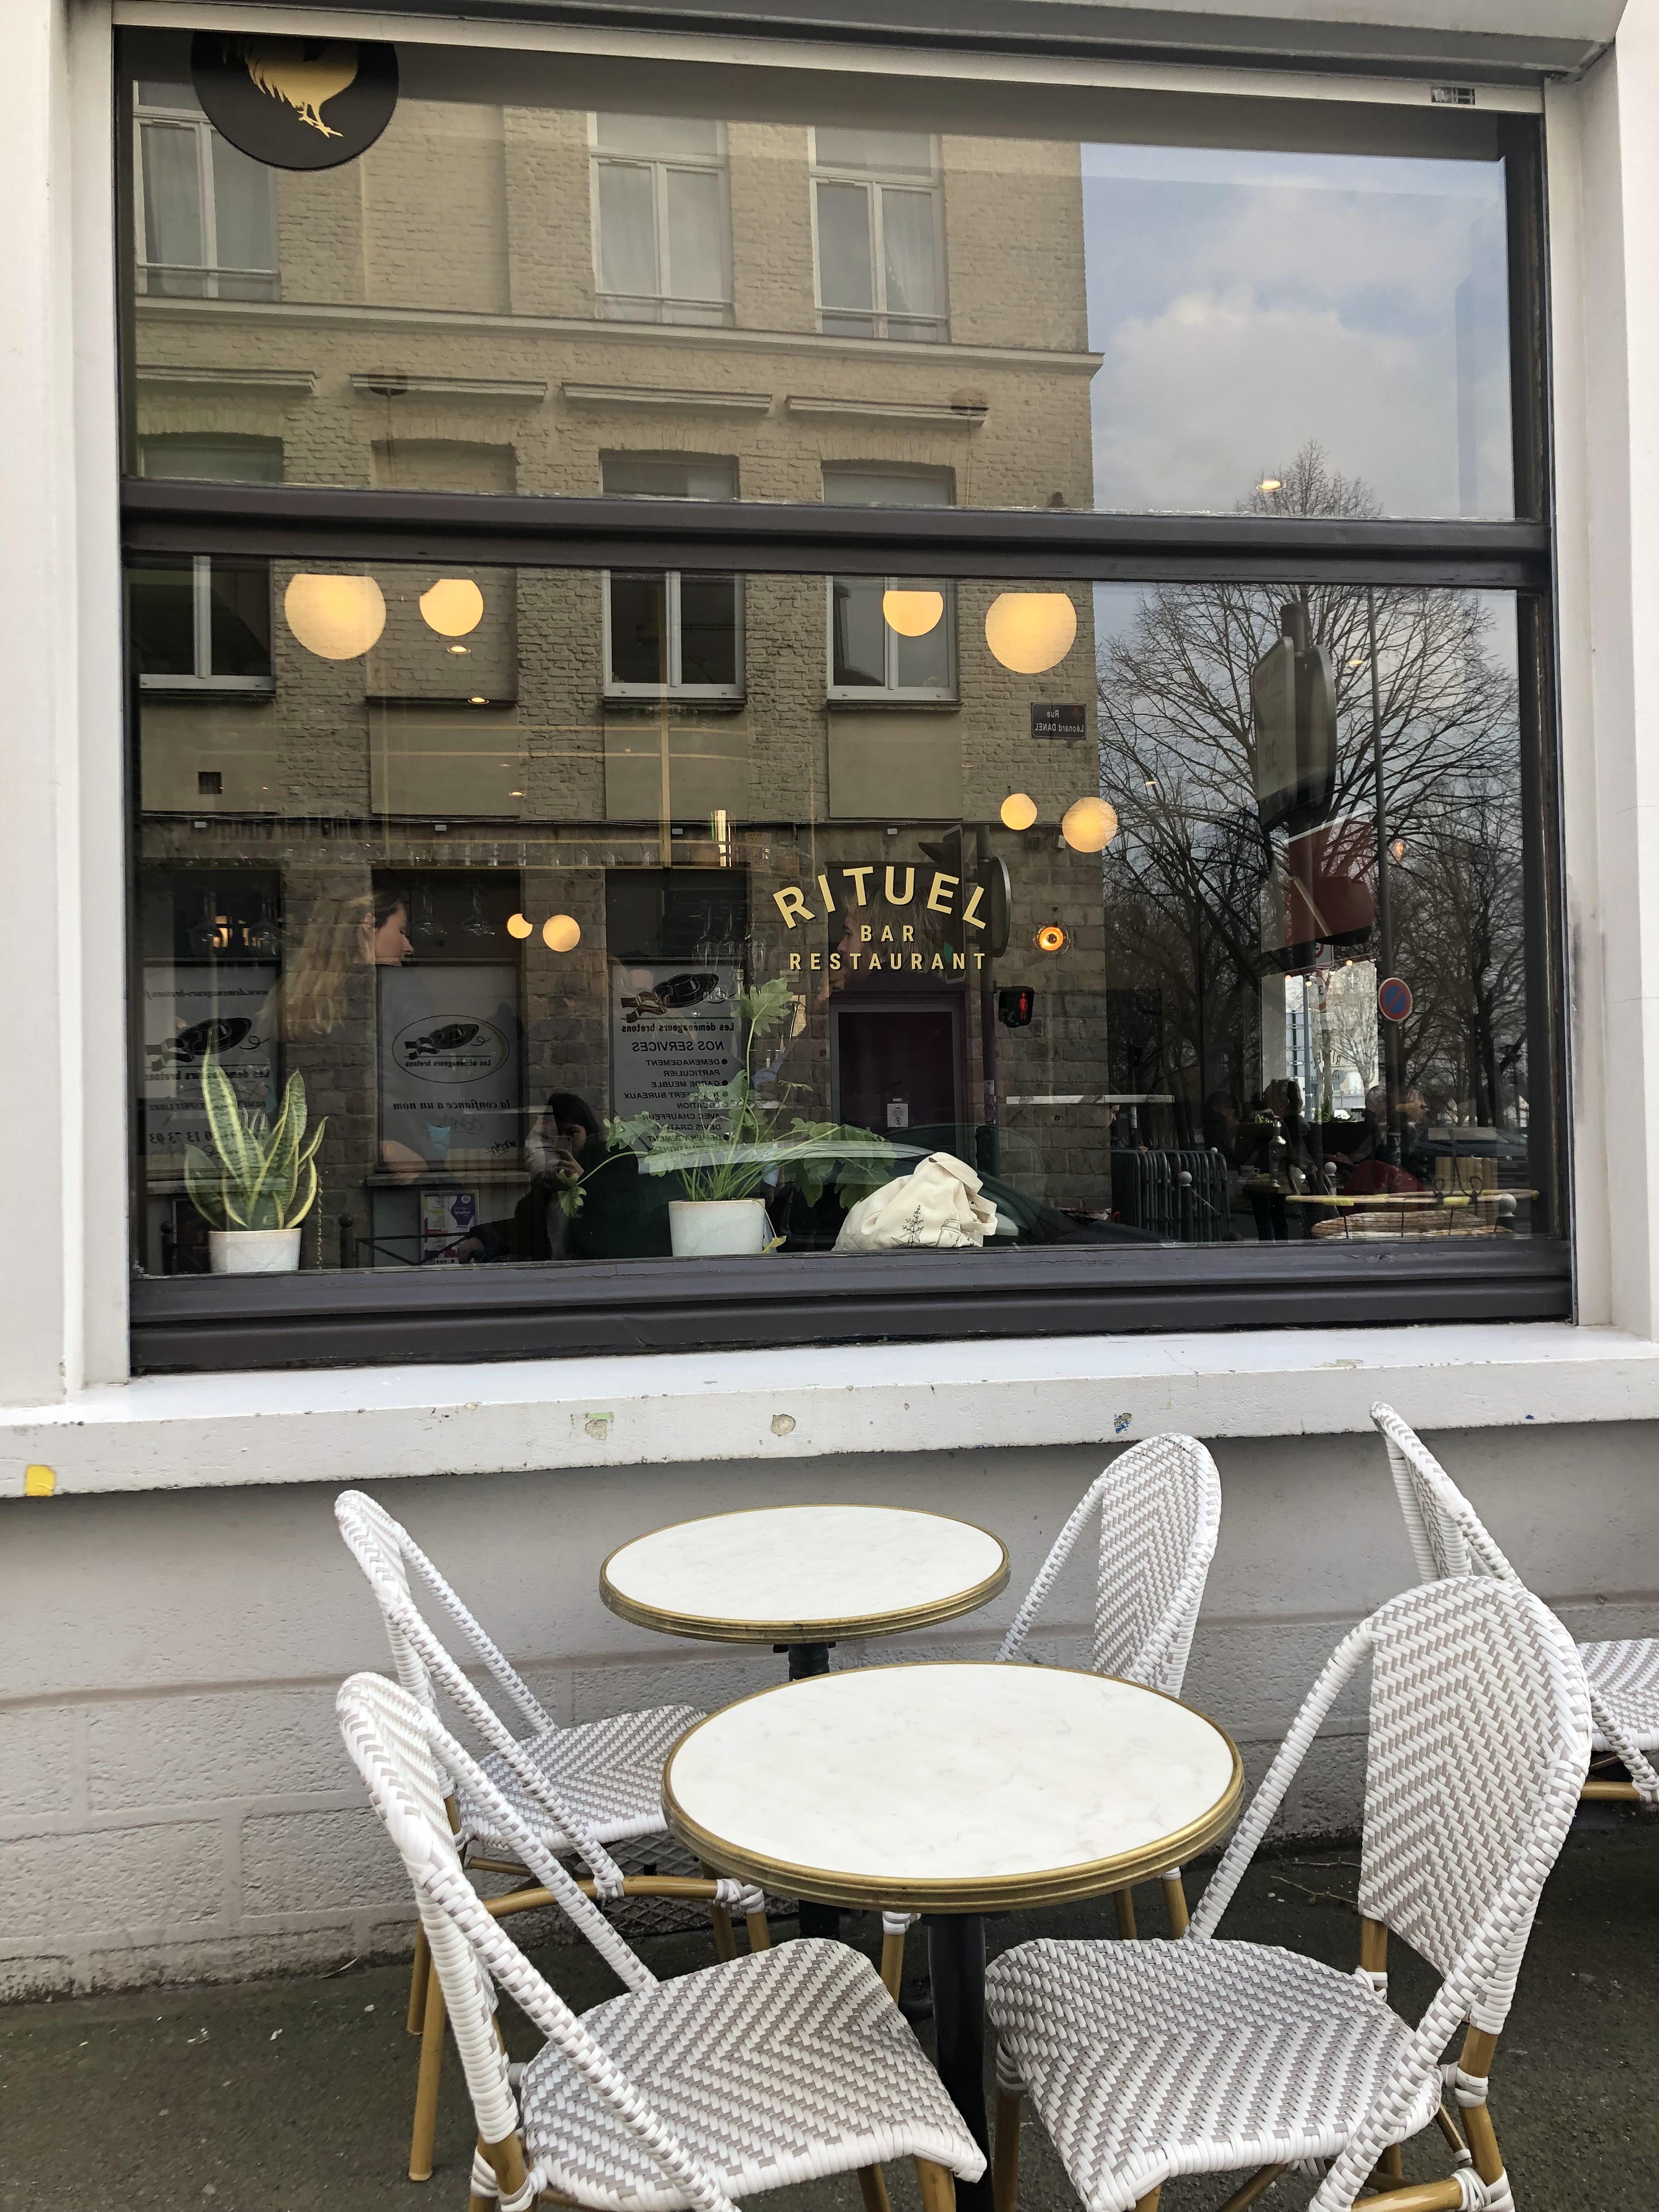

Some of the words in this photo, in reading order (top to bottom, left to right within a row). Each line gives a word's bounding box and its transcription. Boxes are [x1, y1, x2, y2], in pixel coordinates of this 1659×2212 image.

[773, 866, 986, 929] RITUEL
[861, 926, 914, 942] BAR
[789, 953, 985, 969] RESTAURANT
